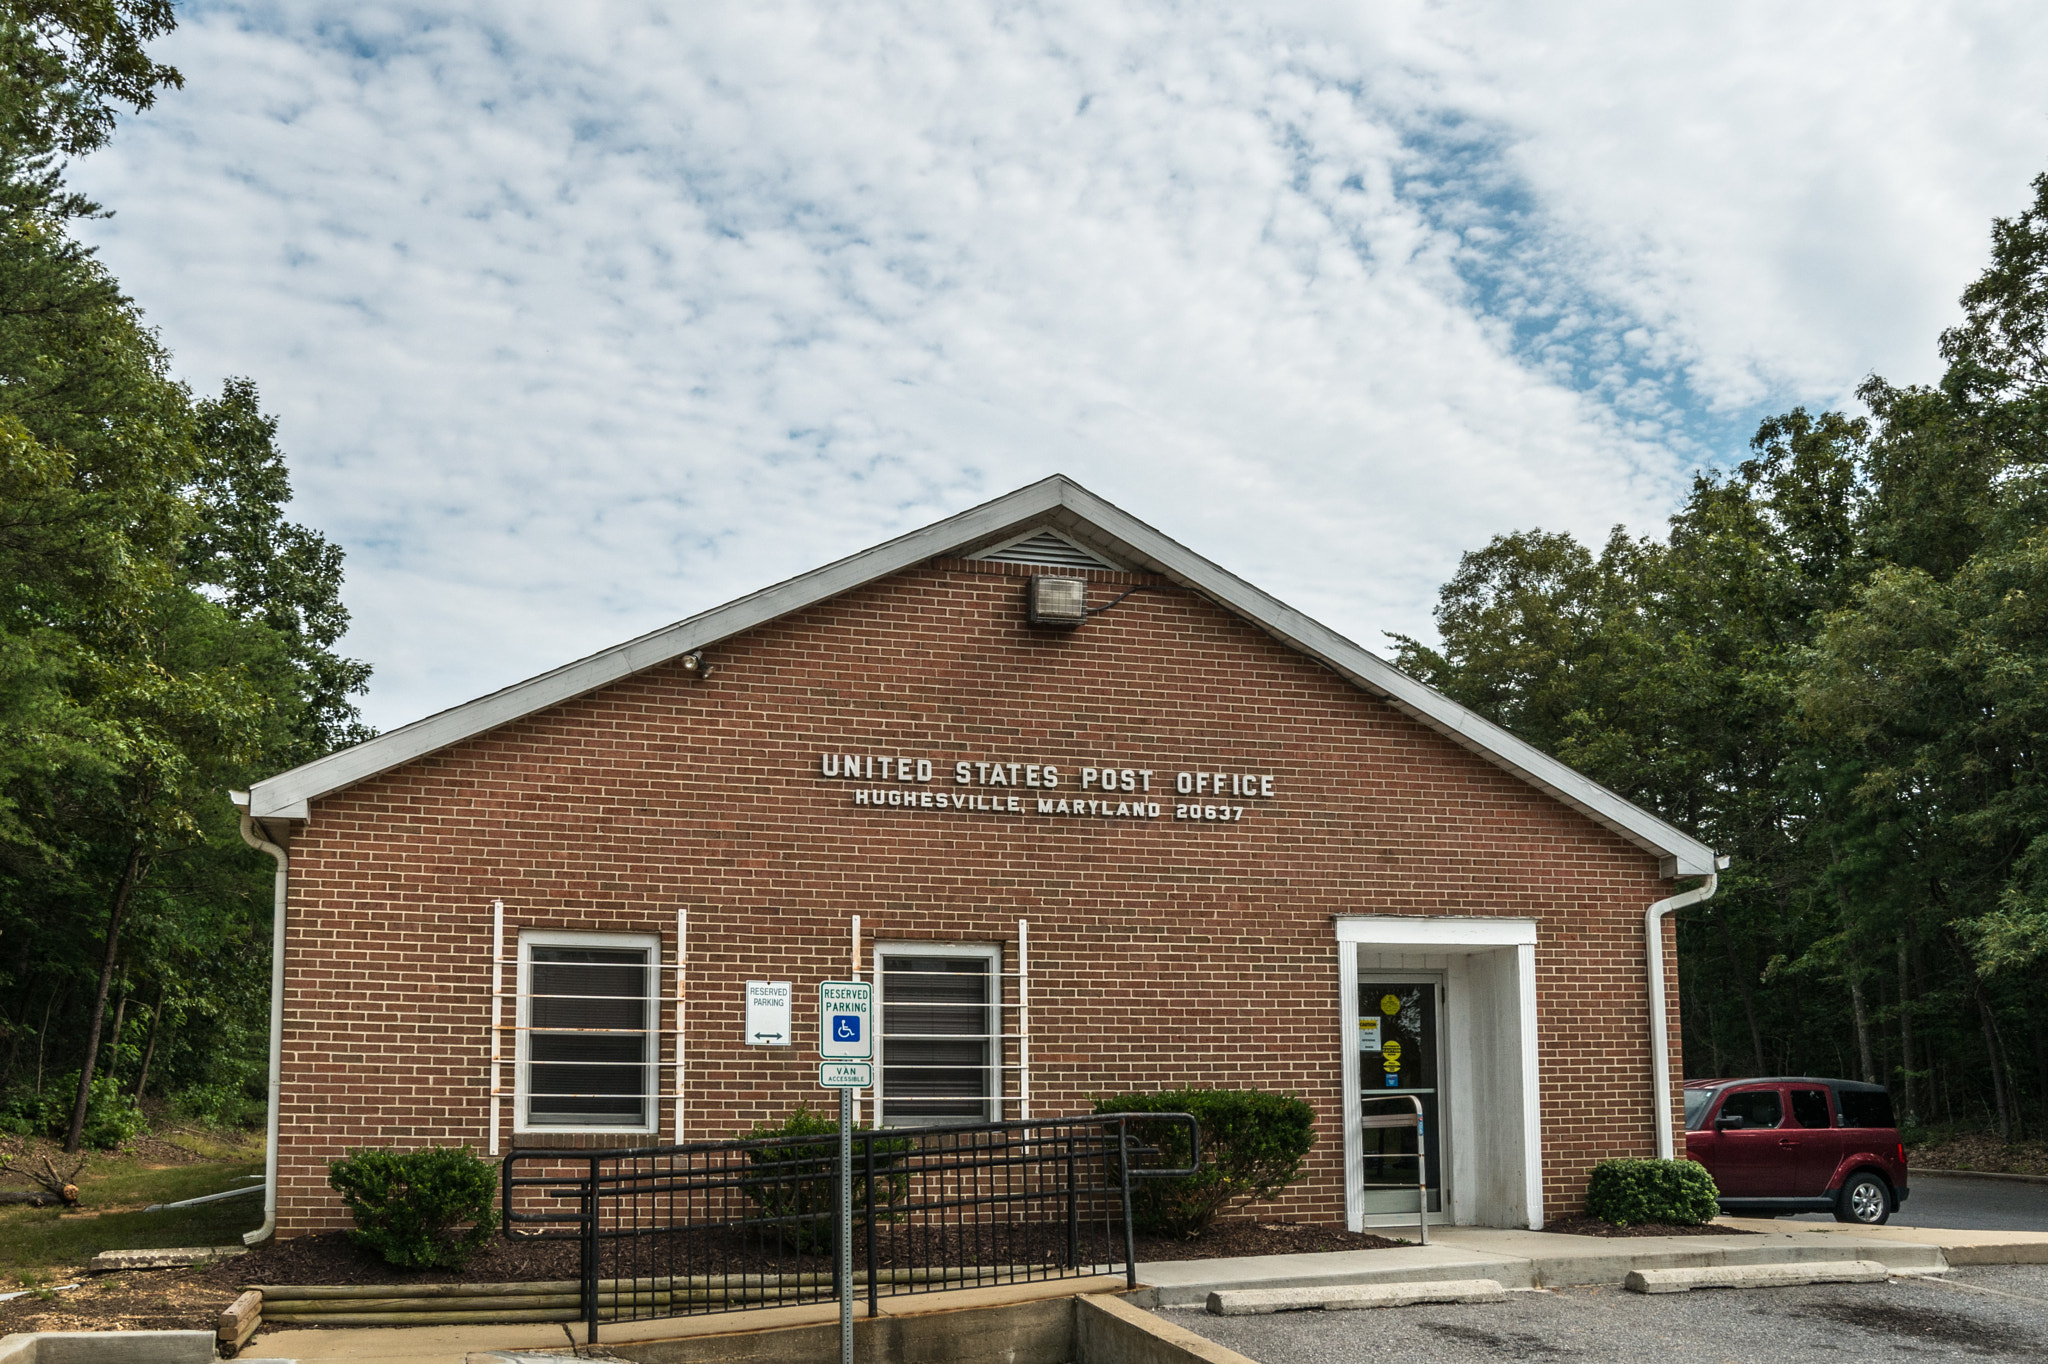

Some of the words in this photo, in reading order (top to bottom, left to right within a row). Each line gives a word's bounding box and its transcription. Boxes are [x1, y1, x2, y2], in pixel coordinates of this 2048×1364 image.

[822, 753, 932, 782] UNITED
[956, 761, 1058, 788] STATES
[1081, 767, 1153, 792] POST
[1177, 772, 1275, 797] OFFICE
[855, 789, 1026, 814] HUGHESVILLE,
[1037, 798, 1160, 818] MARYLAND
[1176, 803, 1244, 821] 20637
[750, 987, 788, 996] RESERVED
[824, 988, 868, 1000] RESERVED
[753, 998, 784, 1007] PARKING
[826, 1002, 867, 1013] PARKING
[836, 1067, 856, 1075] VAN
